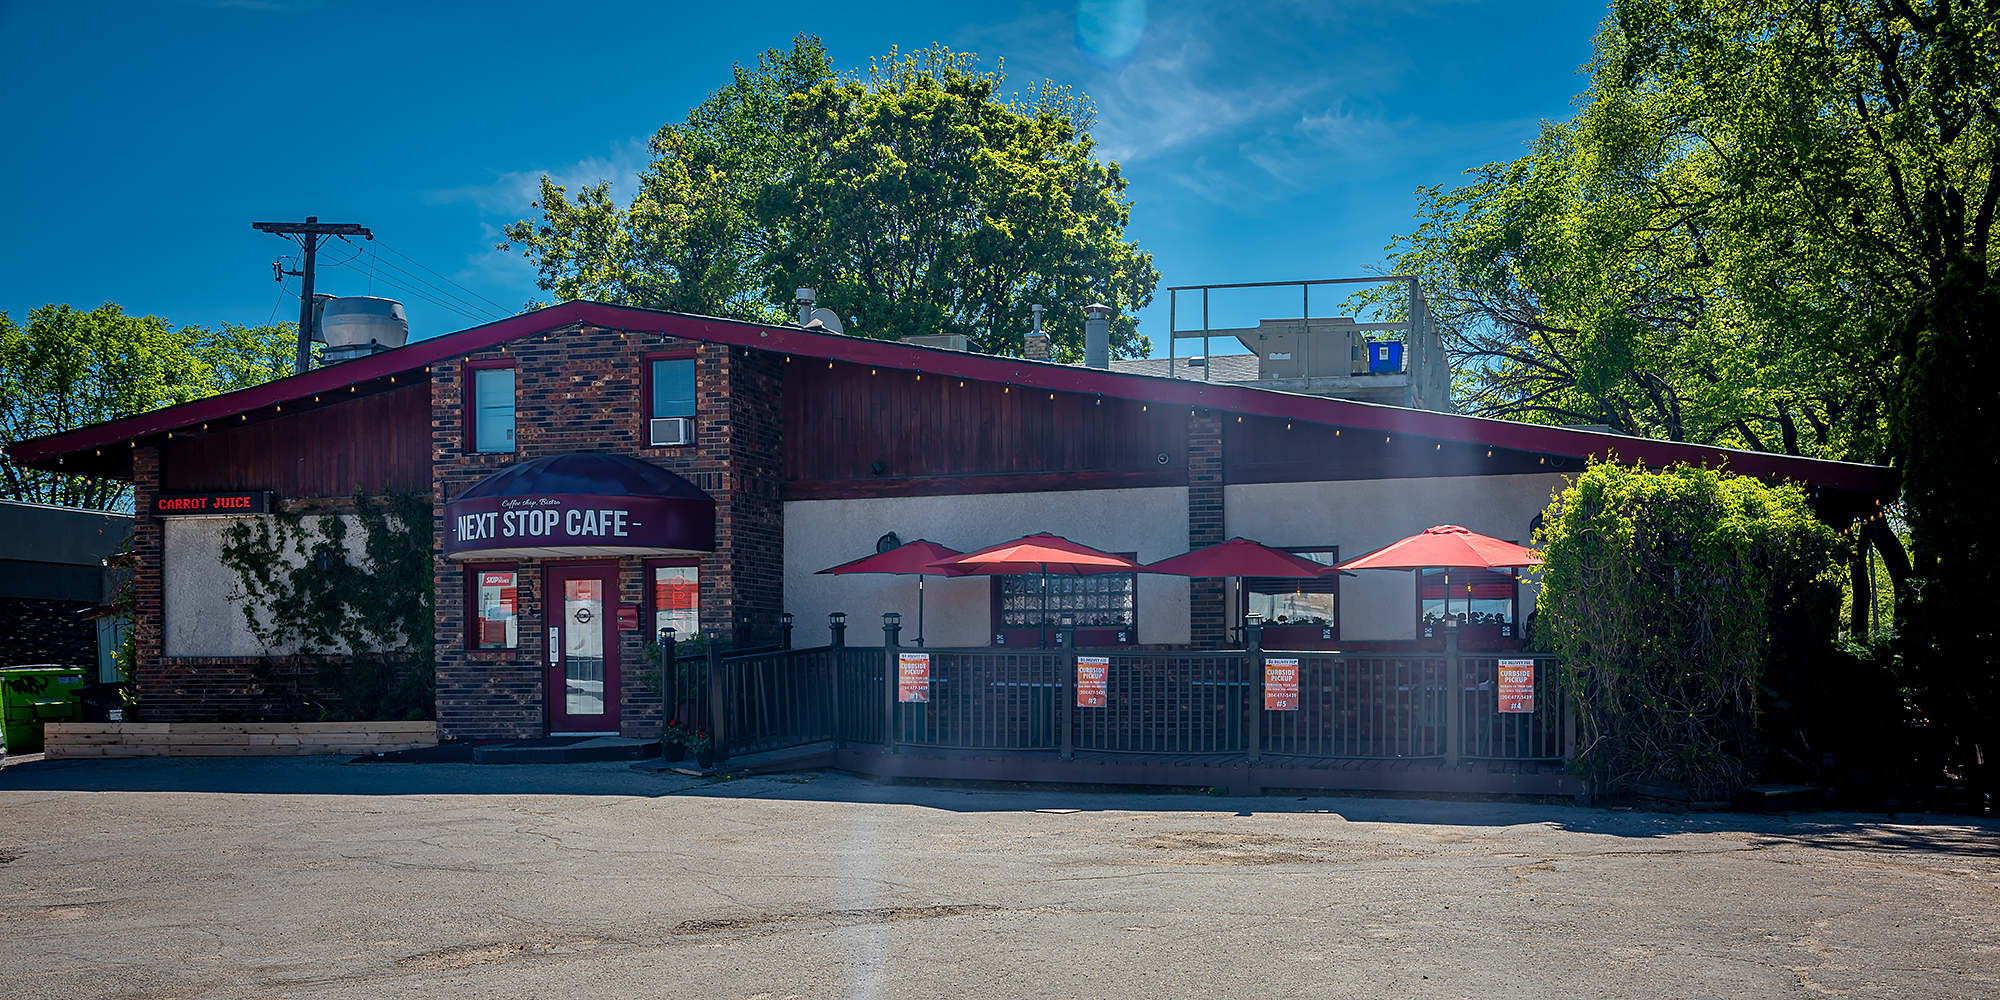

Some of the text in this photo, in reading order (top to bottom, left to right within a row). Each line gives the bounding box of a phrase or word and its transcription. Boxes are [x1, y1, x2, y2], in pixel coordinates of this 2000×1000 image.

[158, 497, 251, 510] CARROT JUICE
[502, 500, 520, 508] Coffee
[458, 510, 628, 542] NEXT STOP CAFE
